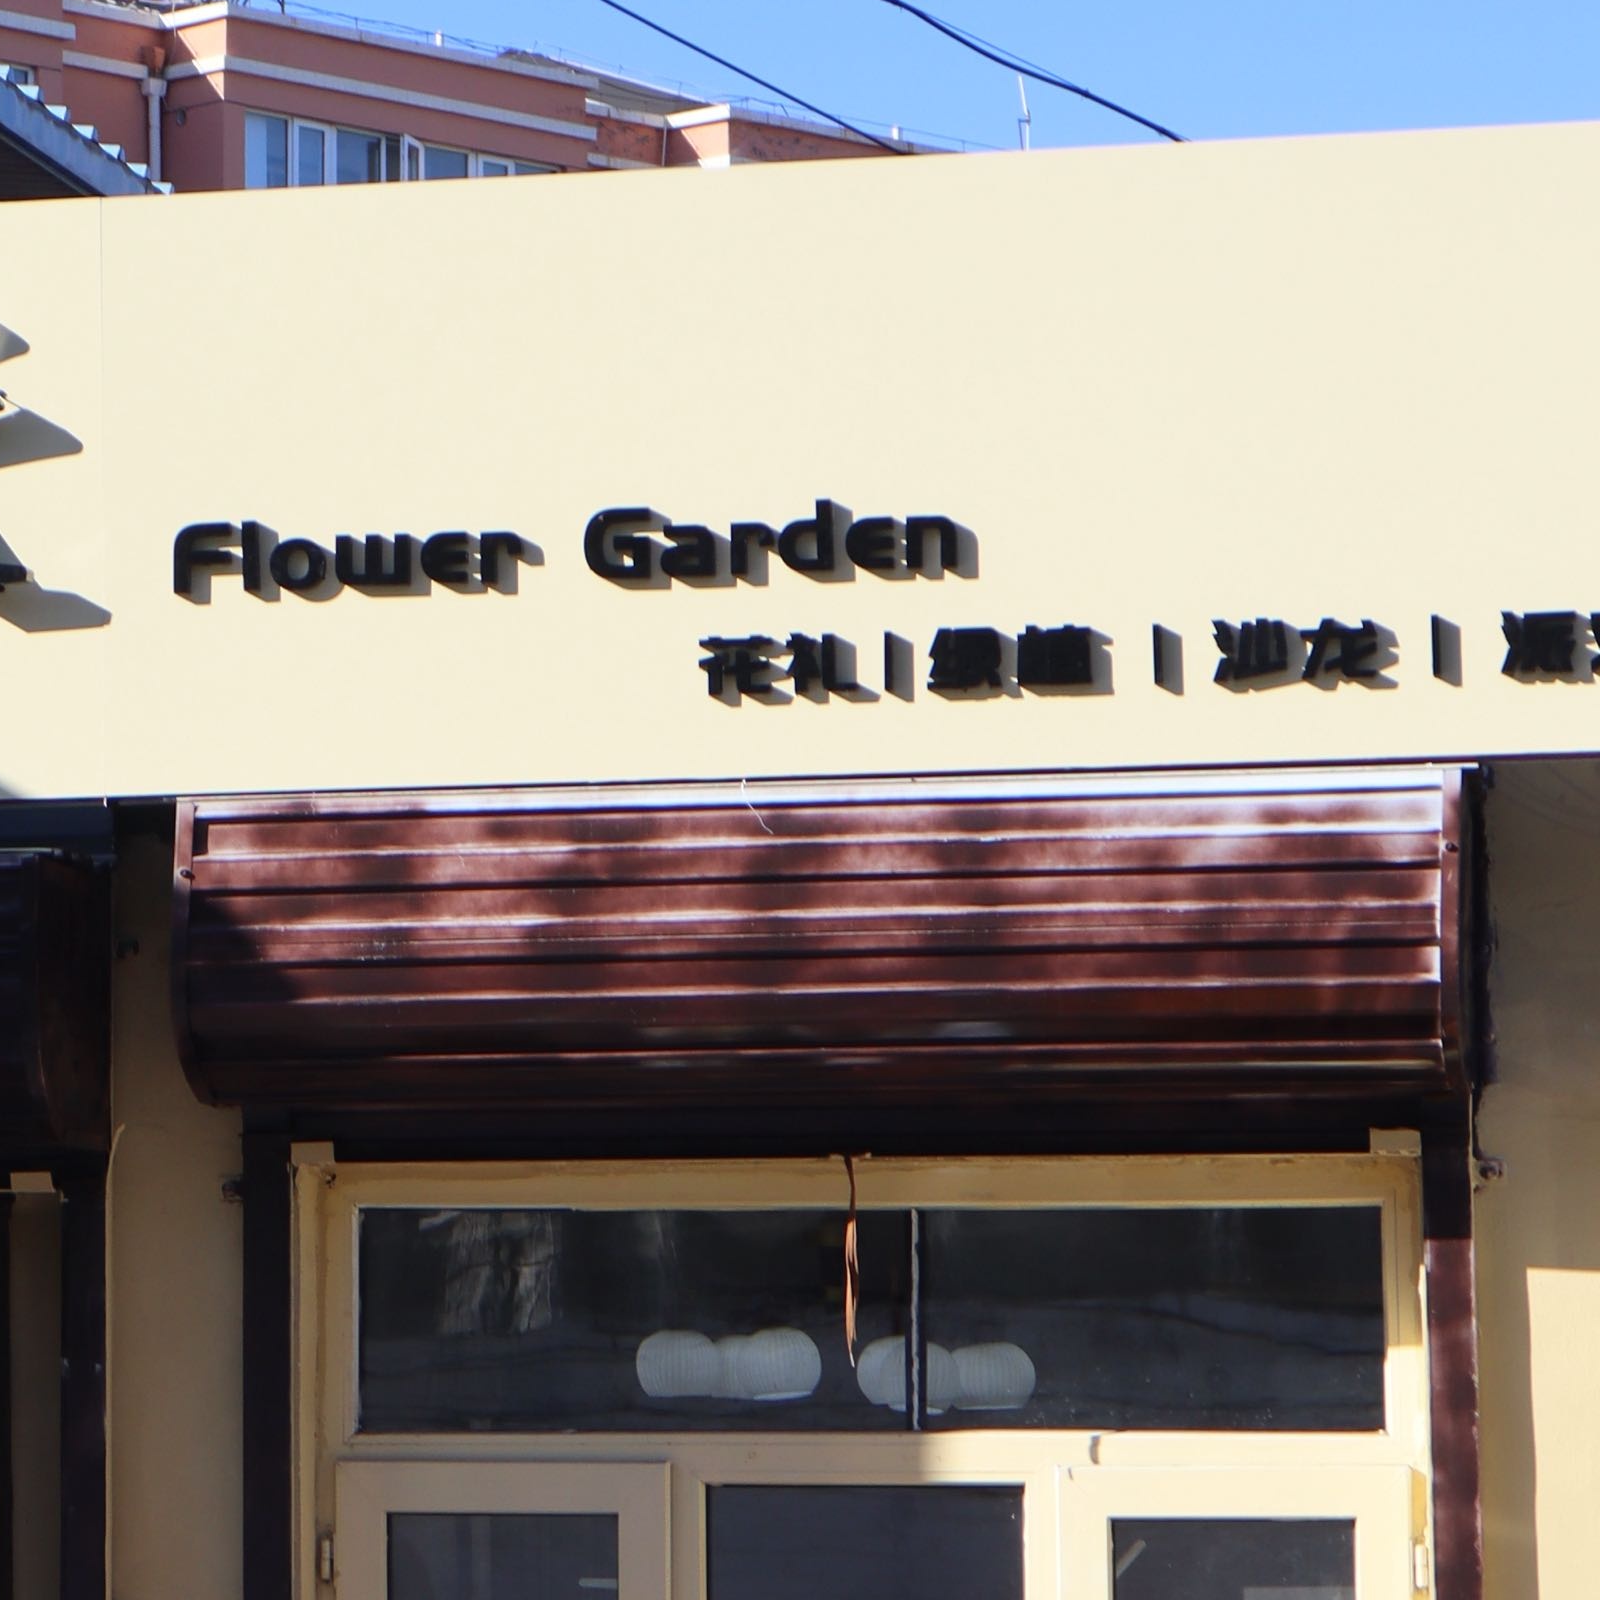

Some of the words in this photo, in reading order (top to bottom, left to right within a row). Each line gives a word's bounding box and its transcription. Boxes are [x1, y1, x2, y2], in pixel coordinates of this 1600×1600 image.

[174, 520, 523, 595] Flower
[584, 498, 960, 580] Garden
[699, 632, 860, 696] 花礼
[1211, 617, 1378, 683] 沙龙
